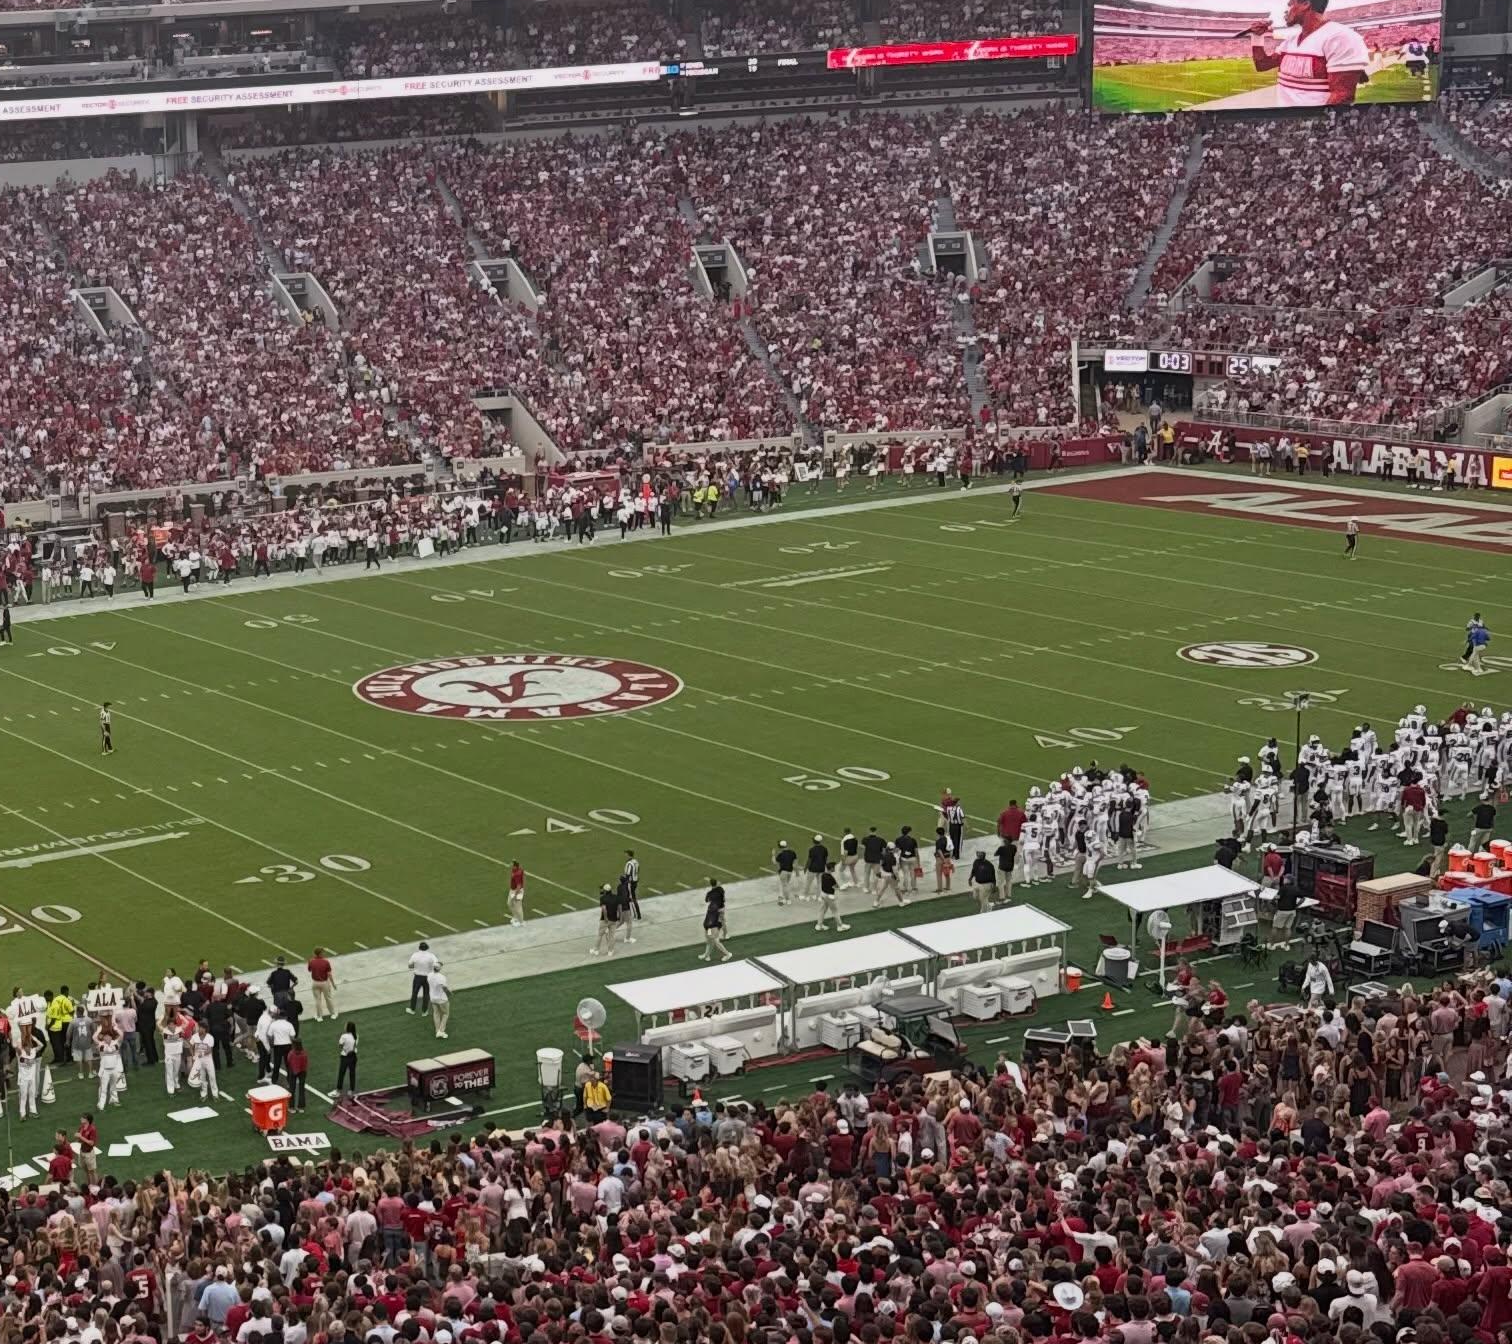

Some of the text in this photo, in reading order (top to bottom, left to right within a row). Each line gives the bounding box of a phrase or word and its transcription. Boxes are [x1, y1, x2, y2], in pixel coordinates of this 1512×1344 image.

[405, 75, 533, 90] FREE SECURITY ASSESSMENT
[166, 90, 294, 105] FREE SECURITY ASSESSMENT
[3, 104, 61, 115] ASSESSMENT
[1159, 353, 1190, 369] 0:03
[1228, 357, 1248, 375] 25
[1032, 726, 1126, 751] 40
[1353, 765, 1360, 776] 3
[783, 766, 892, 792] 50
[543, 807, 642, 836] 40
[1031, 827, 1038, 838] 5
[259, 852, 373, 886] 30
[94, 992, 116, 1007] ALA
[17, 999, 37, 1018] ALA
[453, 1068, 489, 1081] FOREVER
[462, 1076, 490, 1090] THEE
[268, 1103, 283, 1121] G
[271, 1136, 326, 1149] BAMA
